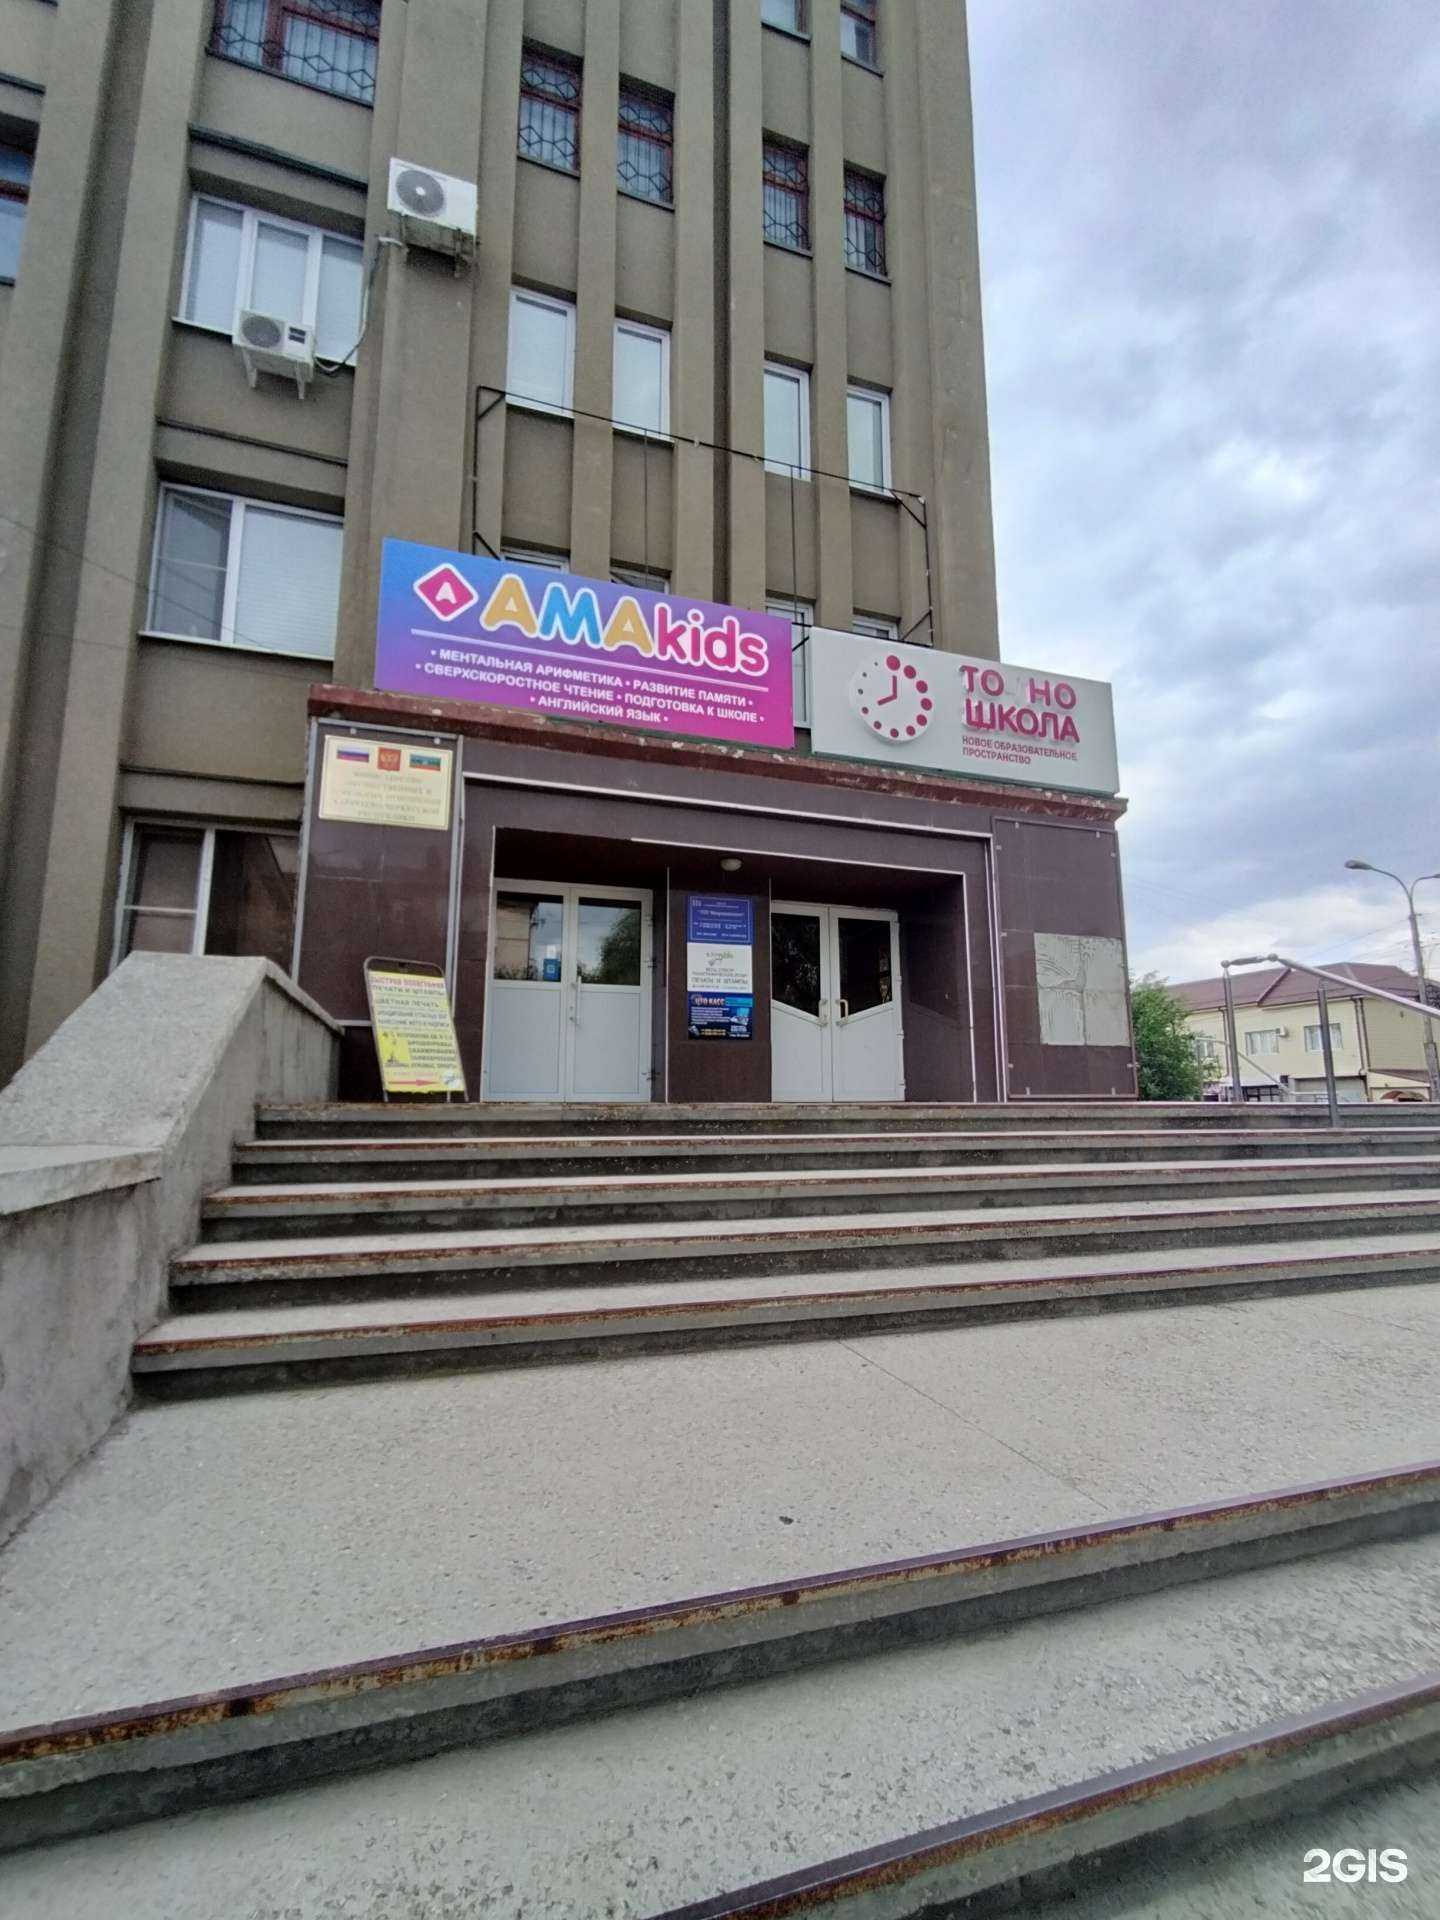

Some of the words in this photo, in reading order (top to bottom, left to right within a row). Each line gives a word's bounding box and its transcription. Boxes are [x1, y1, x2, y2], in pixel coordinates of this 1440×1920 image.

[480, 573, 769, 677] AMAkids
[424, 663, 561, 692] СВЕРХСКОРОСТНОЕ
[563, 683, 614, 701] ЧТЕНИЕ
[624, 693, 704, 715] ПОДГОТОВКА
[707, 708, 714, 716] К
[717, 709, 758, 723] ШКОЛЕ
[439, 649, 533, 672] МЕНТАЛЬНАЯ
[535, 664, 623, 687] АРИФМЕТИКА
[633, 680, 696, 698] РАЗВИТИЕ
[698, 691, 746, 707] ПАМЯТИ
[537, 695, 624, 716] АНГЛИЙСКИЙ
[626, 709, 661, 722] ЯЗЫК
[964, 698, 1081, 743] ШКОЛА
[962, 735, 993, 749] НОВОЕ
[993, 740, 1079, 761] ОБРАЗОВАТЕЛЬНОЕ
[962, 749, 1032, 765] ПРОСТРАНСТВО
